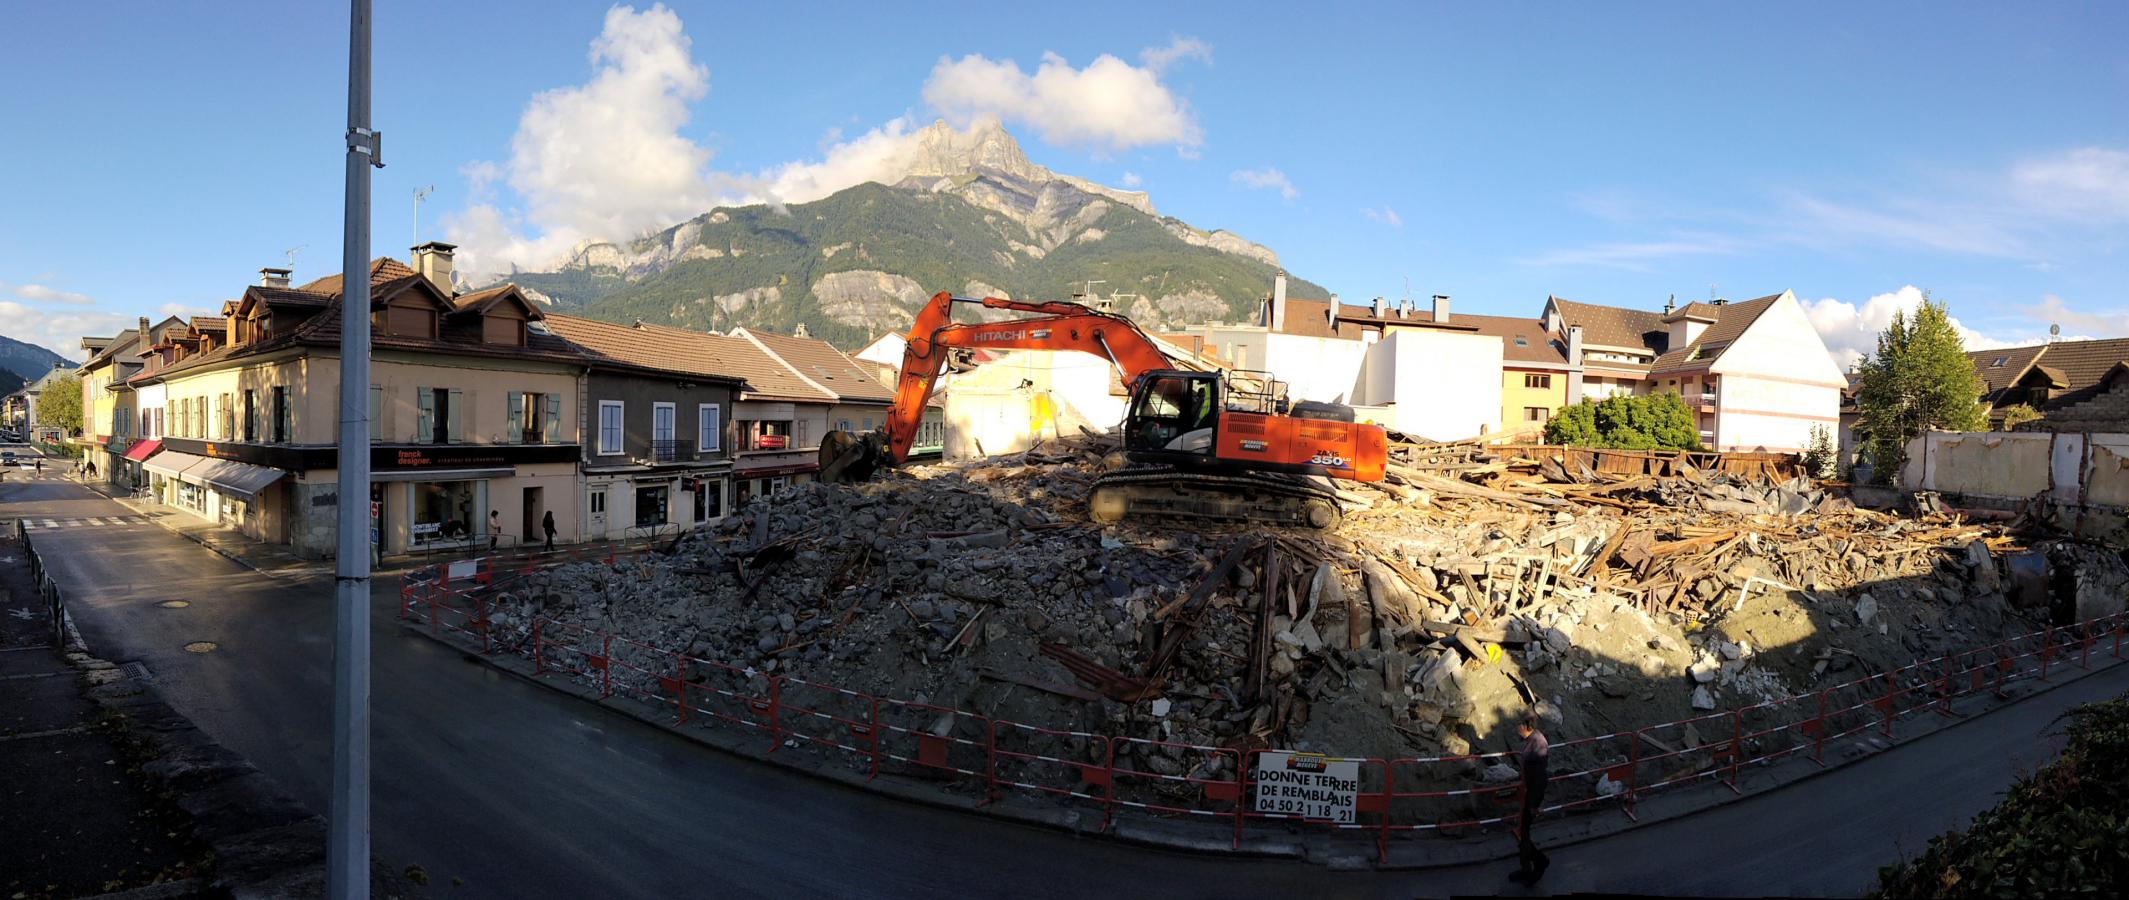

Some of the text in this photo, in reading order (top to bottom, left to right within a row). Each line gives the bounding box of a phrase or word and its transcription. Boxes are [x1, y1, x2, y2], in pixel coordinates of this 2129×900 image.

[974, 329, 1026, 341] HITACHI
[1311, 454, 1344, 466] 350
[1260, 770, 1310, 785] DONNE
[1262, 785, 1277, 796] DE
[1260, 799, 1274, 810] 04
[1279, 801, 1293, 811] 50
[1318, 805, 1331, 816] 18
[1340, 810, 1352, 821] 21
